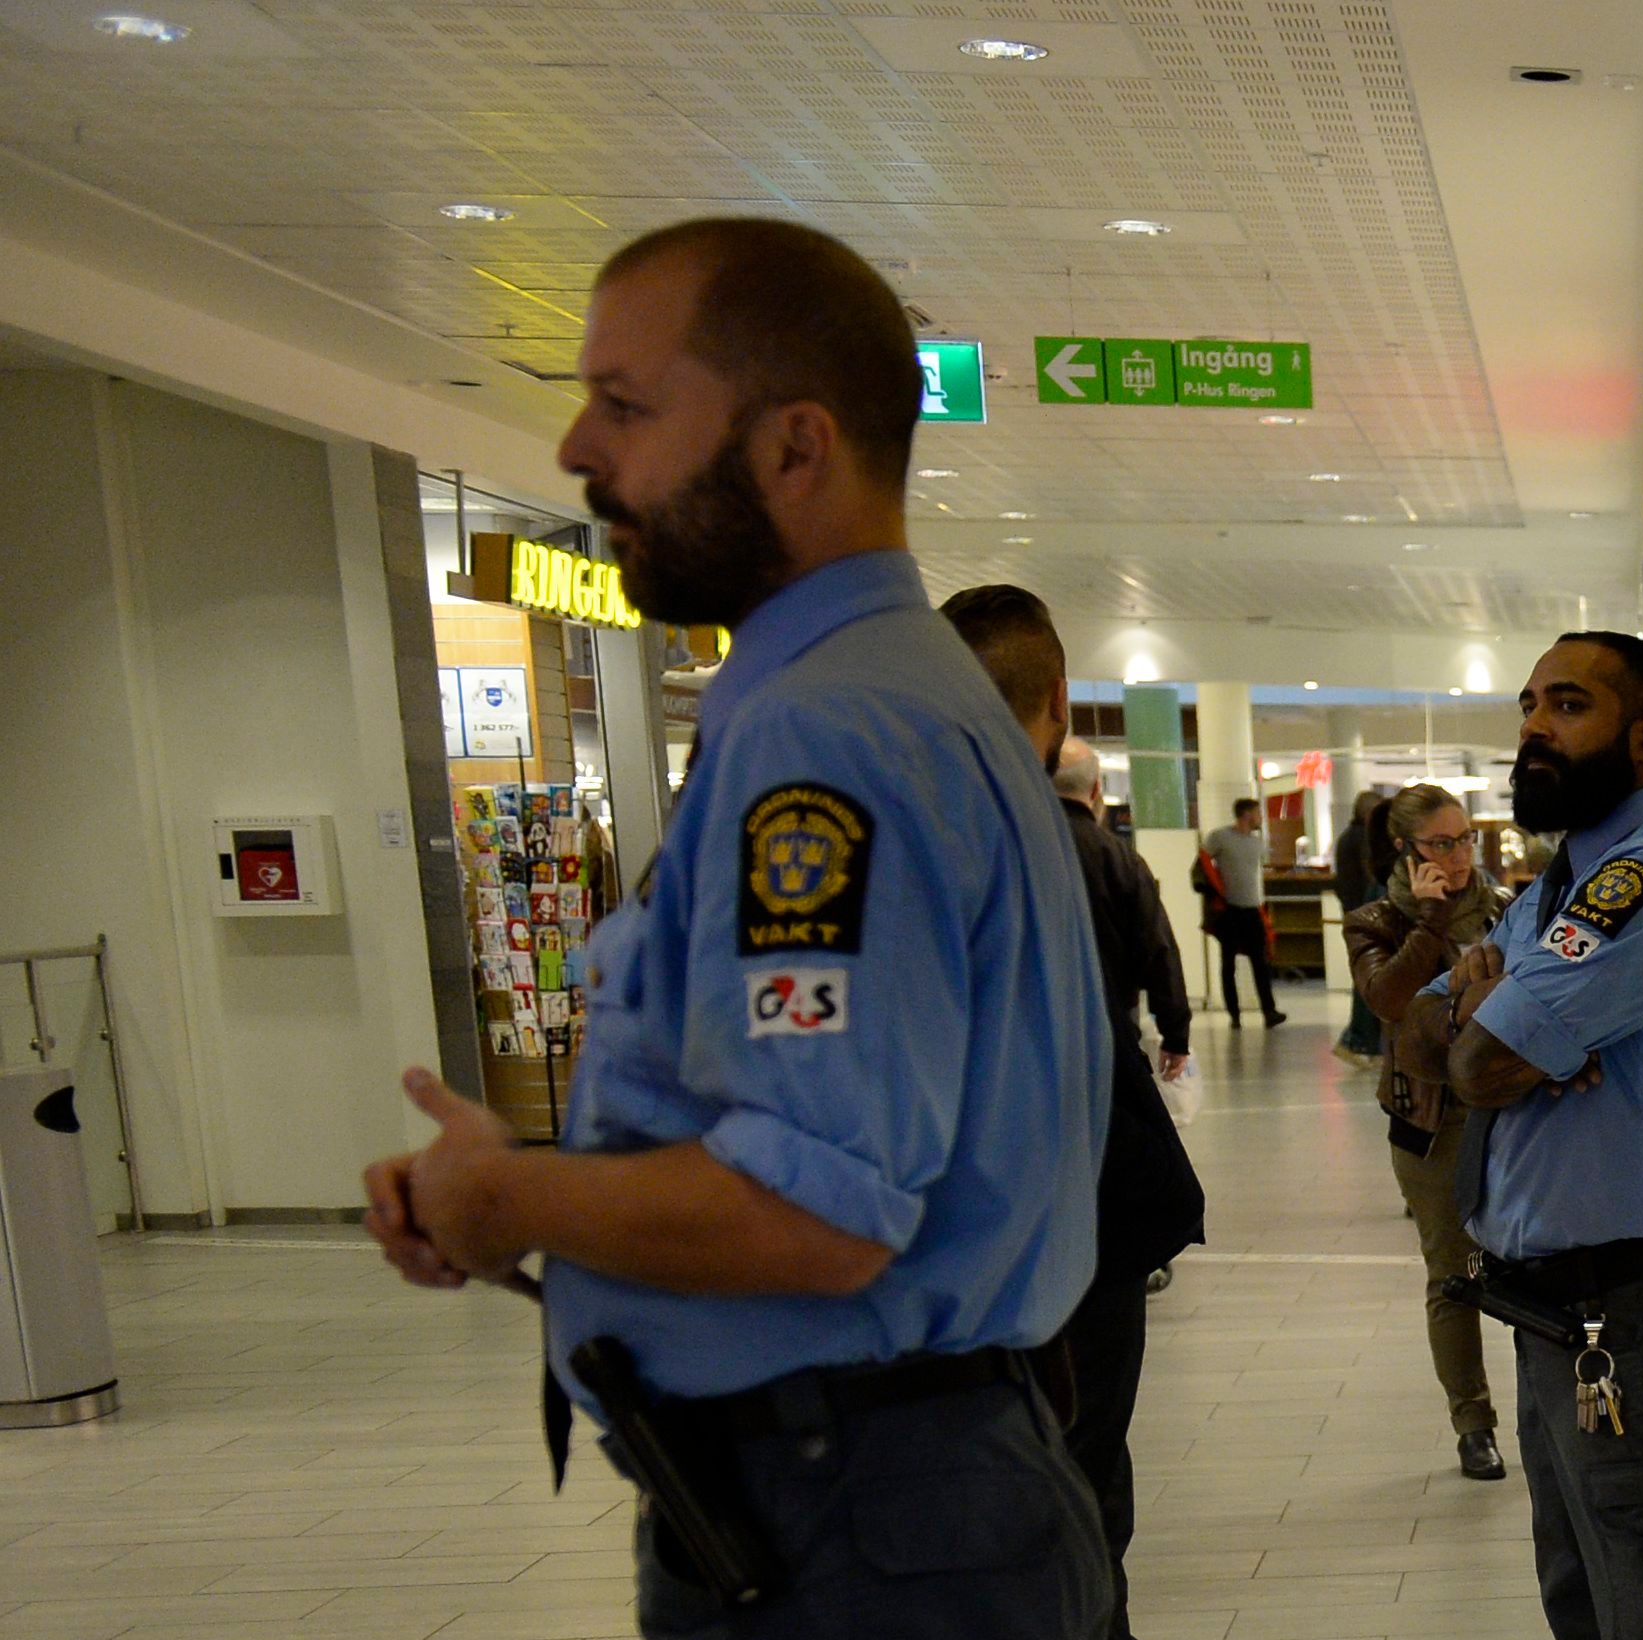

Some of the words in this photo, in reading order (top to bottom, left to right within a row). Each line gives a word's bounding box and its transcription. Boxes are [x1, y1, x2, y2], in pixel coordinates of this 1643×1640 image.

[1181, 343, 1273, 376] Ingång
[1184, 382, 1224, 397] P-Hus
[1228, 383, 1276, 401] Ringen
[1570, 904, 1614, 927] VAKT
[749, 922, 841, 947] VAKT
